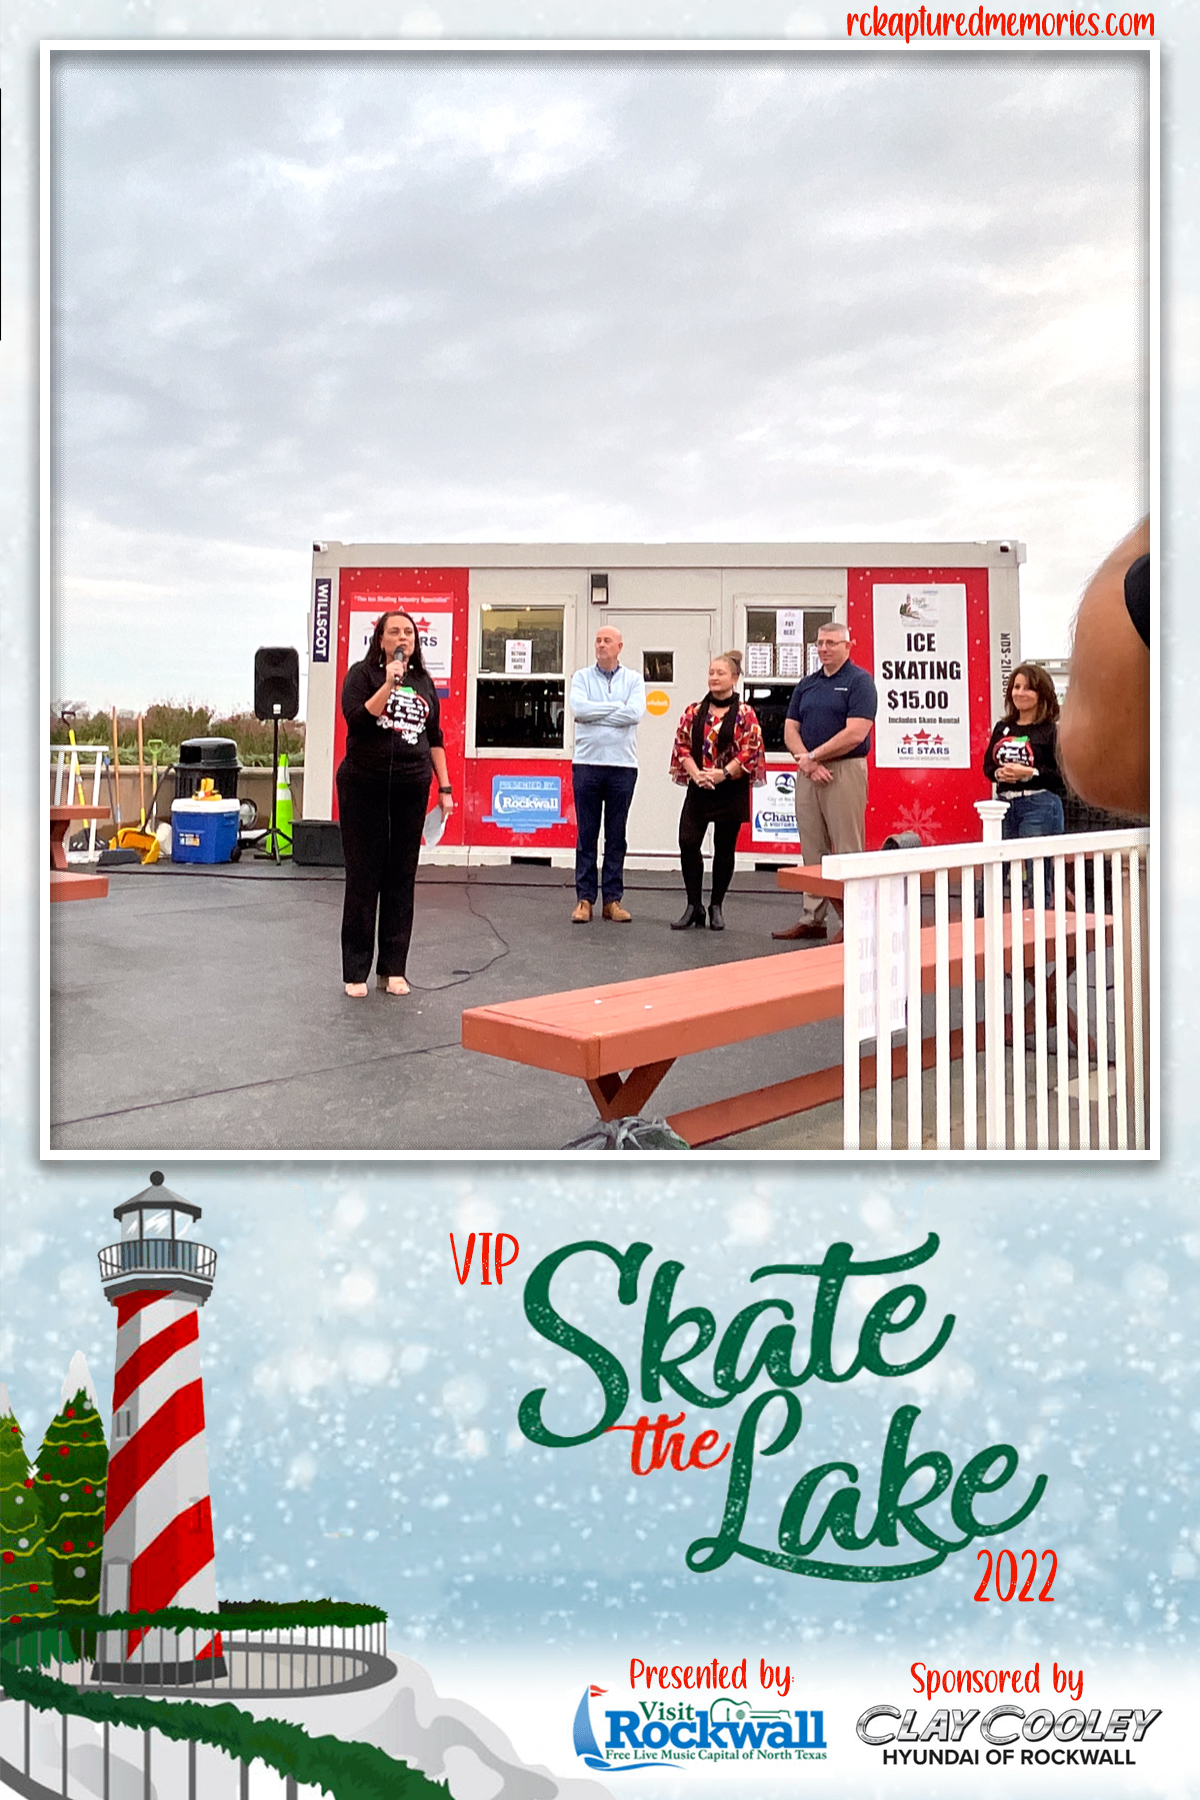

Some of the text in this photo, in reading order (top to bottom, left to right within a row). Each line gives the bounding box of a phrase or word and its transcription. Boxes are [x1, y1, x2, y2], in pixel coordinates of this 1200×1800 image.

[315, 584, 329, 657] WILLSCOT
[906, 632, 936, 652] ICE
[882, 661, 961, 681] SKATING
[887, 689, 949, 711] $15.00
[888, 716, 960, 724] Includes Skate Rental
[897, 747, 950, 755] ICE STARS
[503, 796, 558, 809] Rockwall
